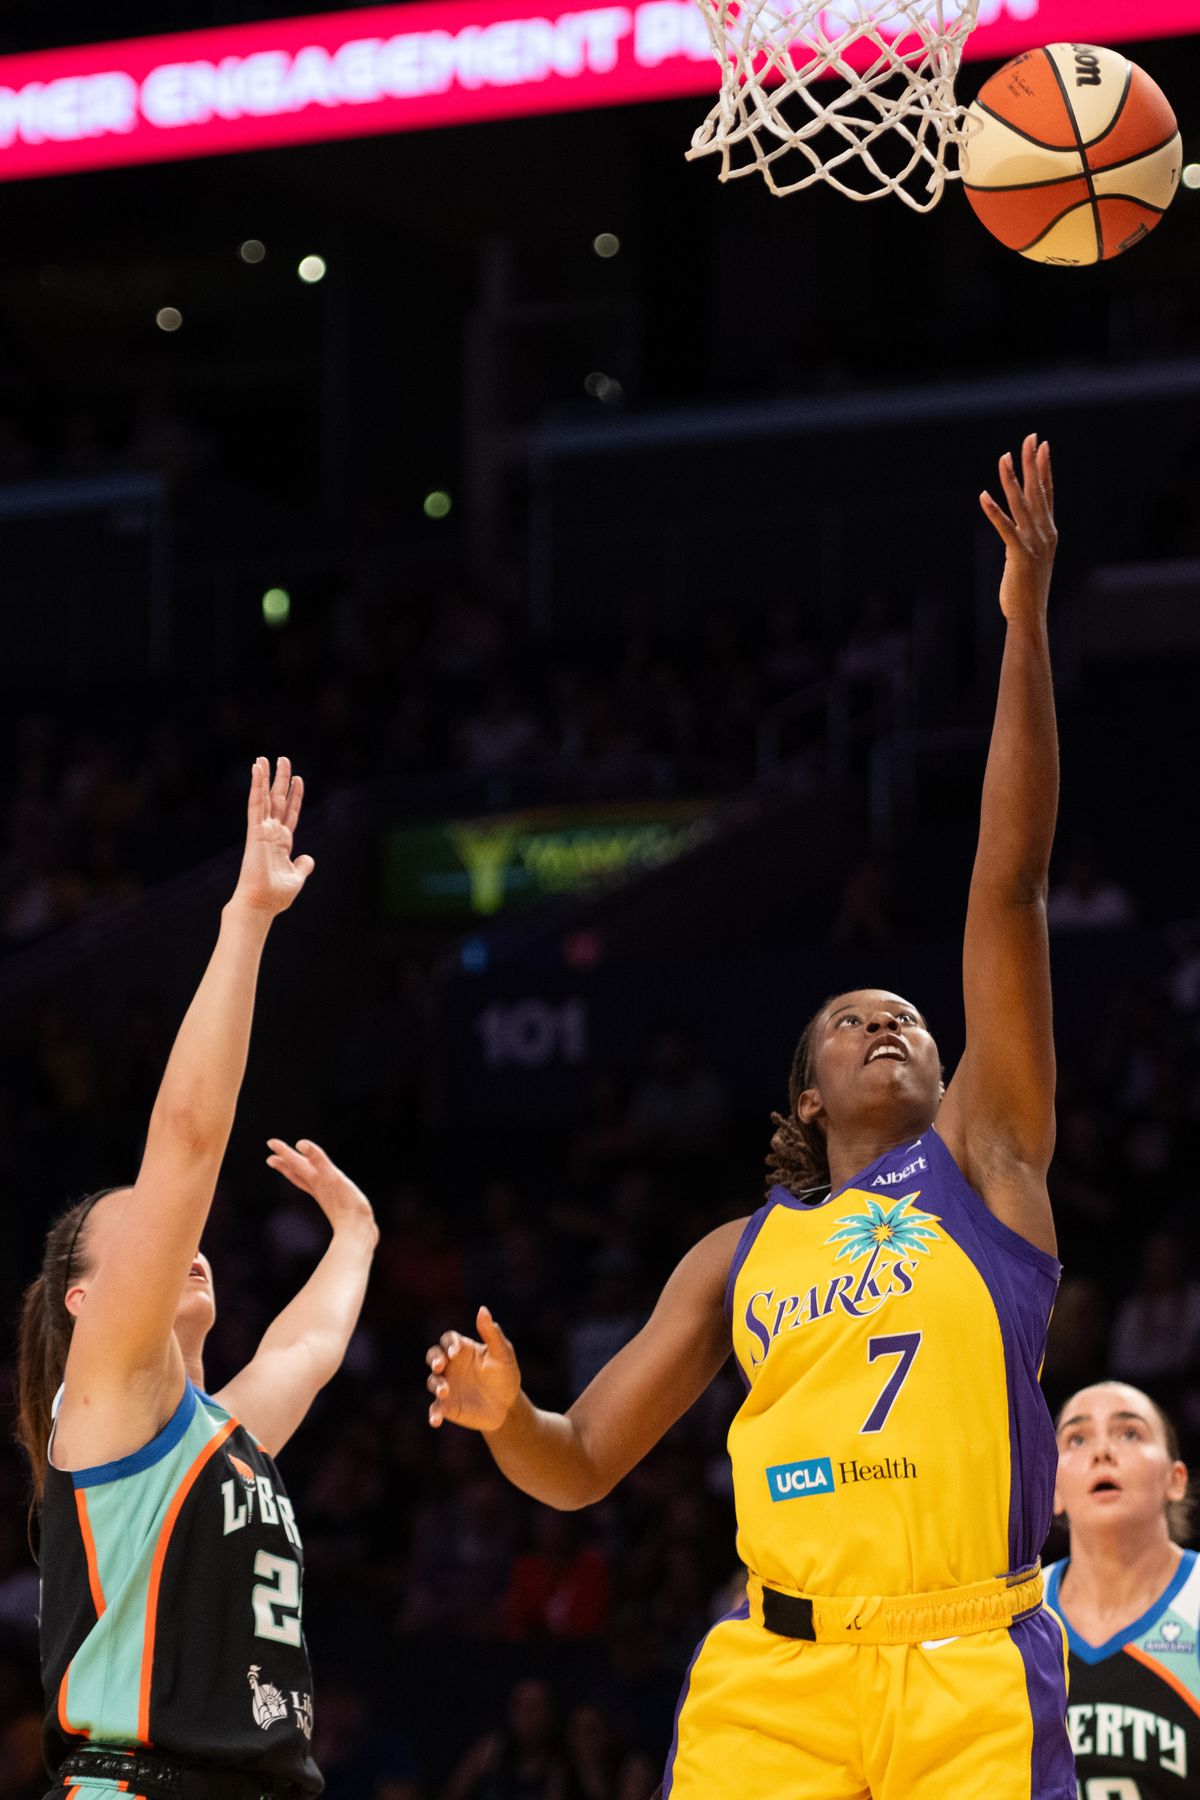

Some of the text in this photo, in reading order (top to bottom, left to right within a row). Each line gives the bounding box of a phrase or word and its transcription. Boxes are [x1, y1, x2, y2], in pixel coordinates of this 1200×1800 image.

[140, 7, 632, 128] ENGAGEMENT
[476, 999, 588, 1064] 101
[870, 1156, 928, 1188] Albert
[744, 1259, 918, 1366] SPARKS
[858, 1330, 922, 1435] 7
[775, 1457, 918, 1494] UCLA Health
